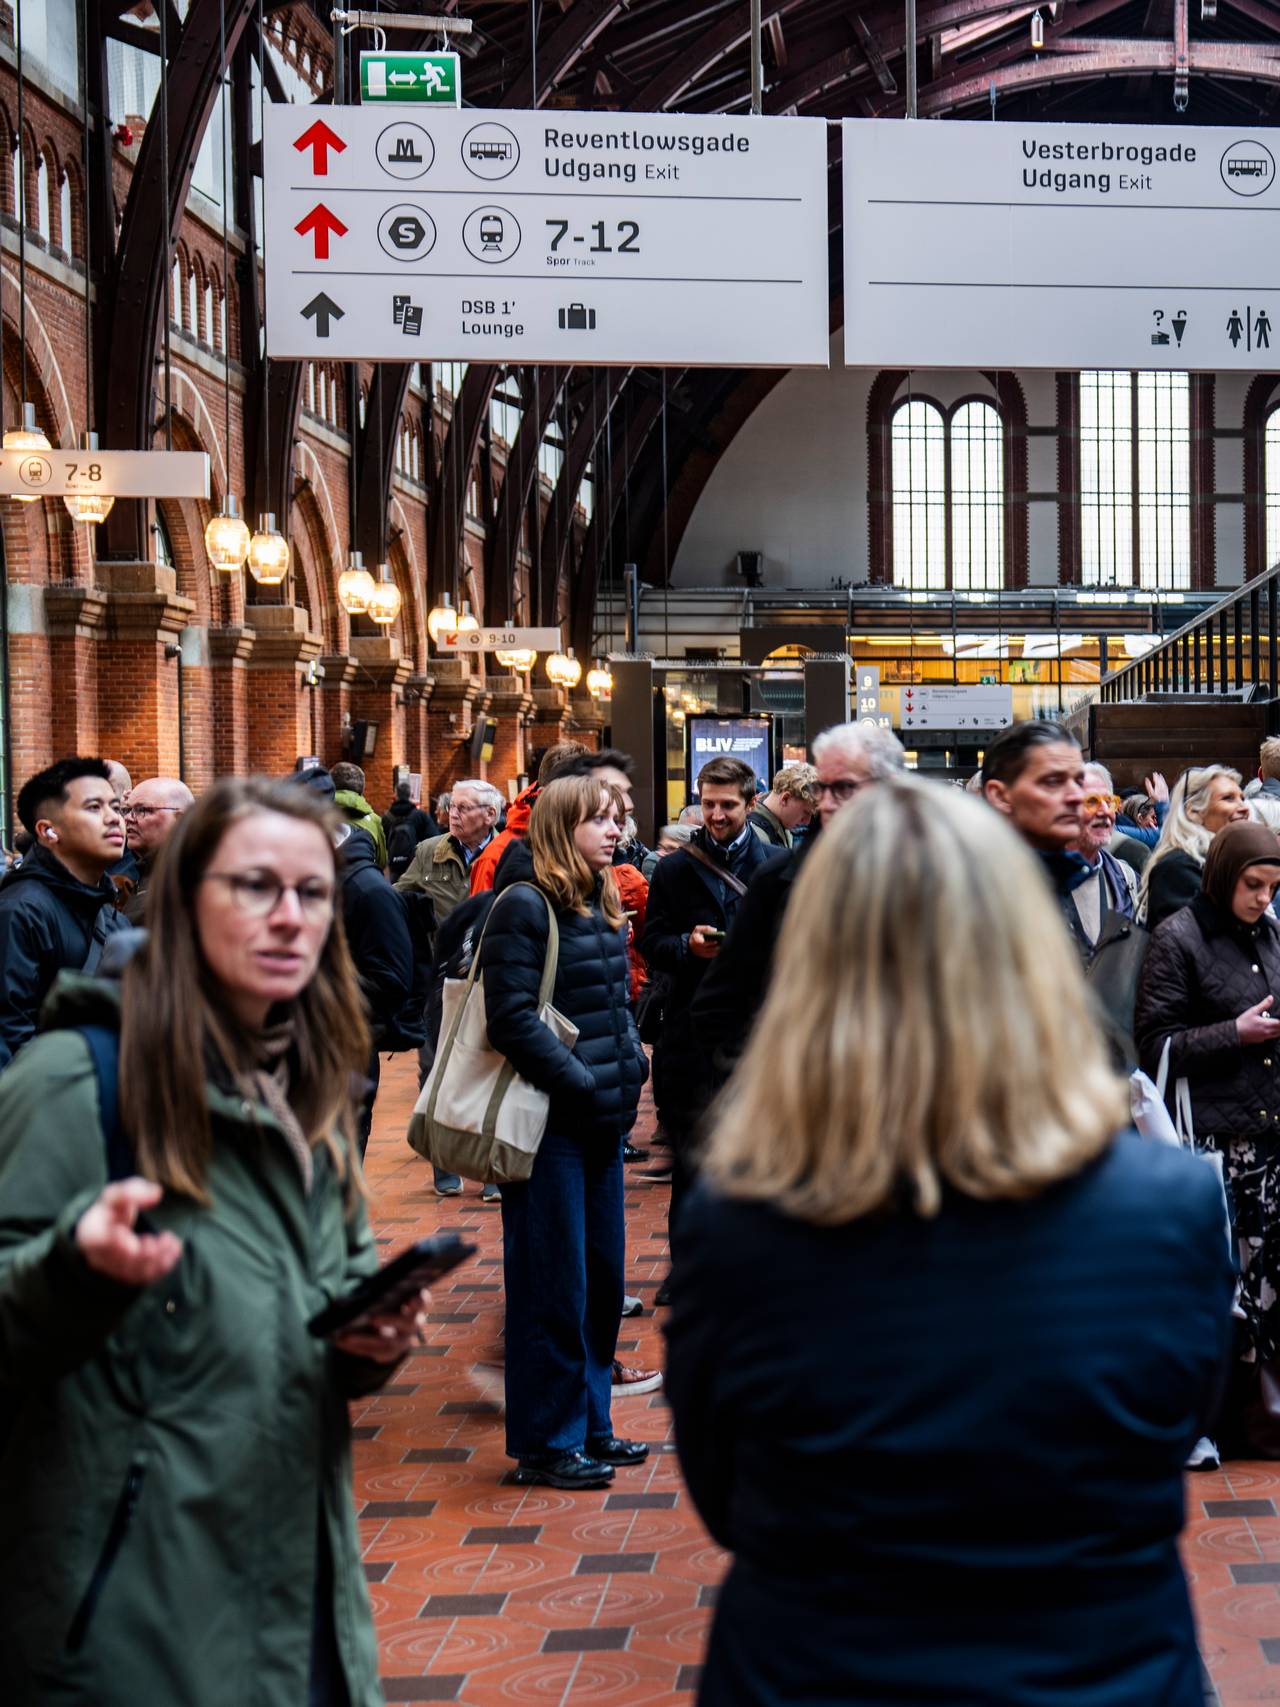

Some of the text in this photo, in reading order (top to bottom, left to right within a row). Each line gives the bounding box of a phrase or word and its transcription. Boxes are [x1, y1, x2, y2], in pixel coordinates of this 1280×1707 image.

[544, 128, 750, 155] Reventlowsgade
[1022, 140, 1197, 165] Vesterbrogade
[544, 158, 680, 182] Udgang Exit
[1022, 169, 1152, 193] Udgang Exit
[545, 219, 641, 254] 7-12
[546, 256, 596, 267] Spor Track
[461, 300, 495, 315] DSB
[461, 320, 524, 338] Lounge
[64, 463, 102, 482] 7-8
[489, 633, 516, 644] 9-10
[695, 738, 733, 752] BLIV
